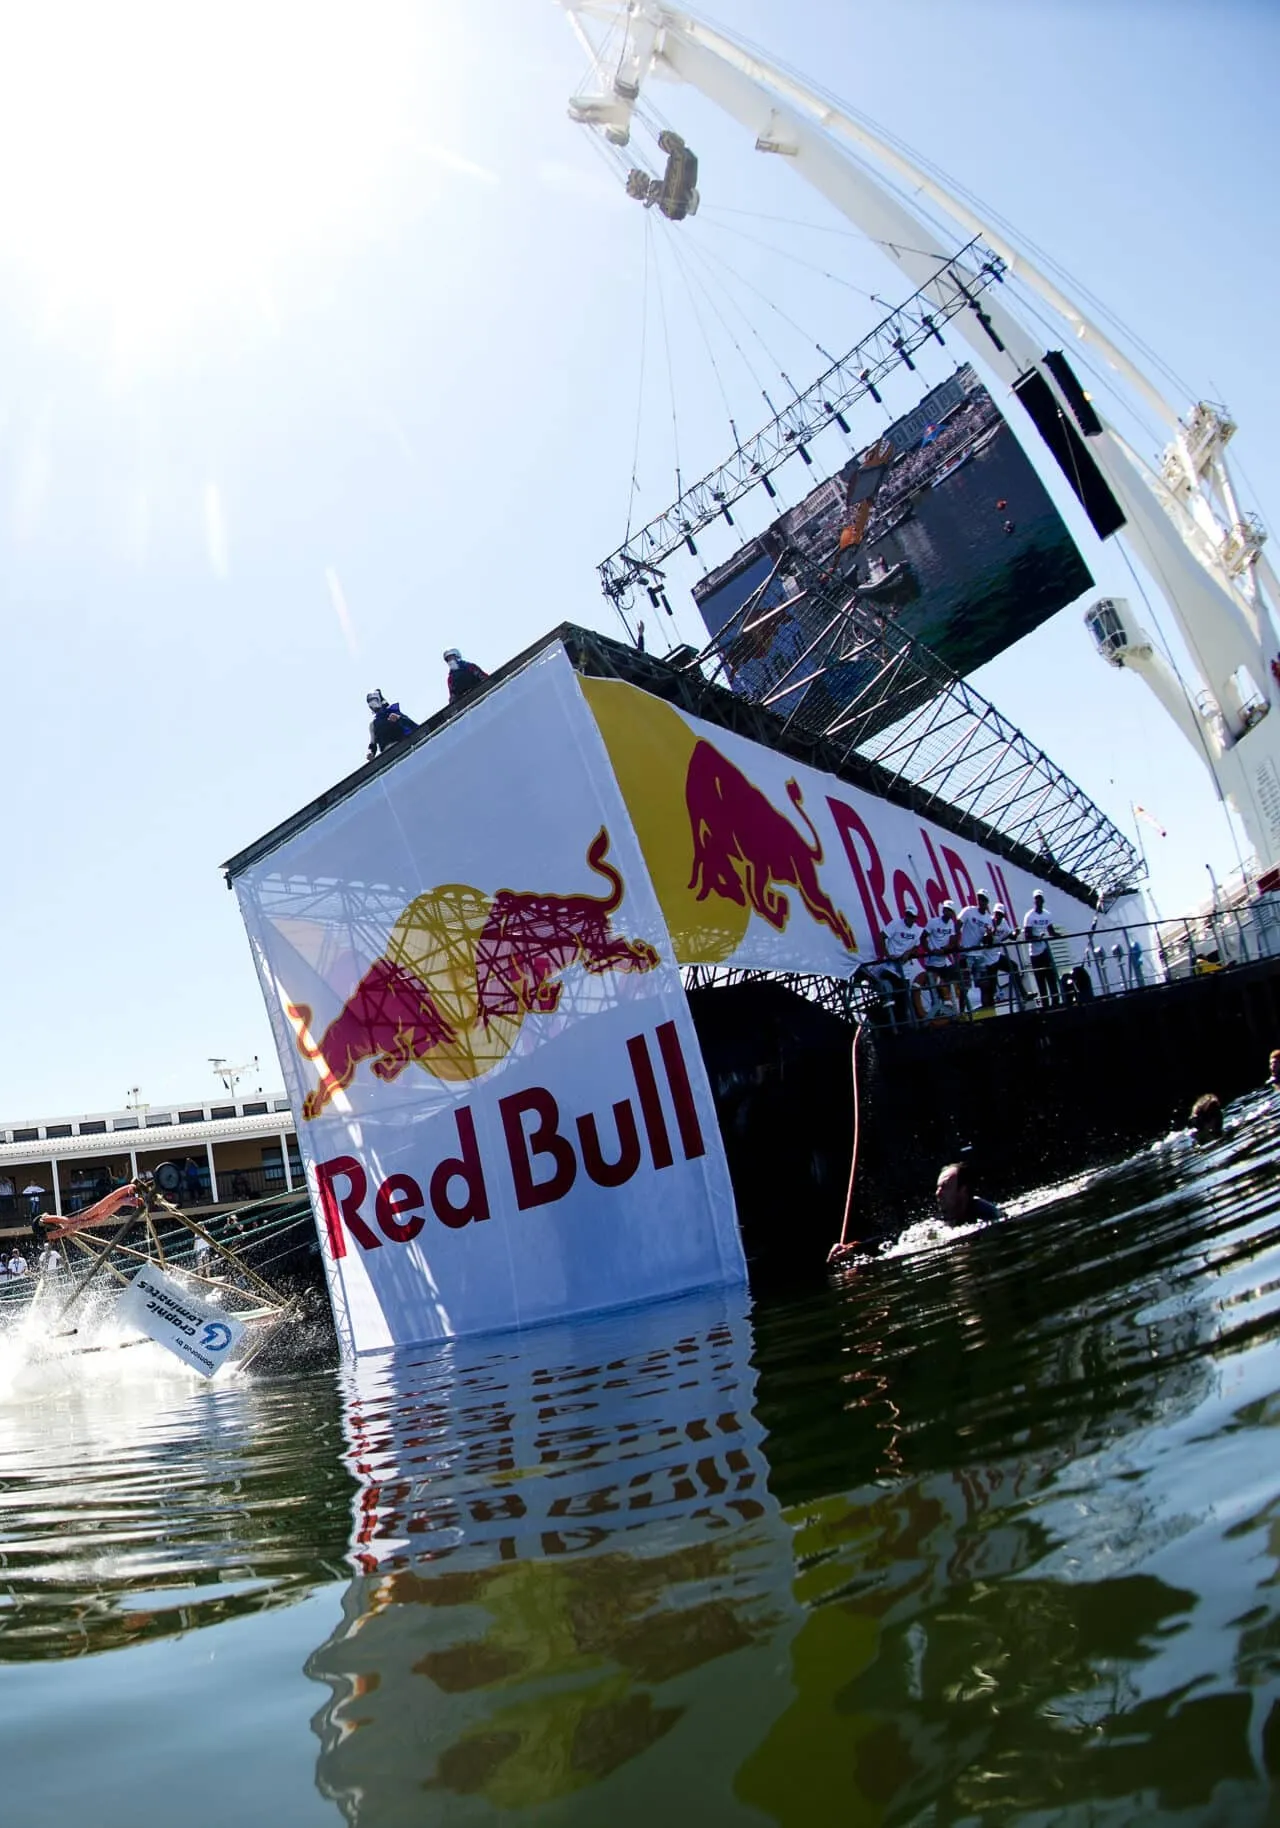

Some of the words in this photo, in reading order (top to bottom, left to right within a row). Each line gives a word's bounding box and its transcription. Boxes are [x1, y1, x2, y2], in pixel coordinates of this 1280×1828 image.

[315, 1105, 491, 1261] Red
[499, 1020, 706, 1211] Bull
[136, 1280, 204, 1327] Laminates
